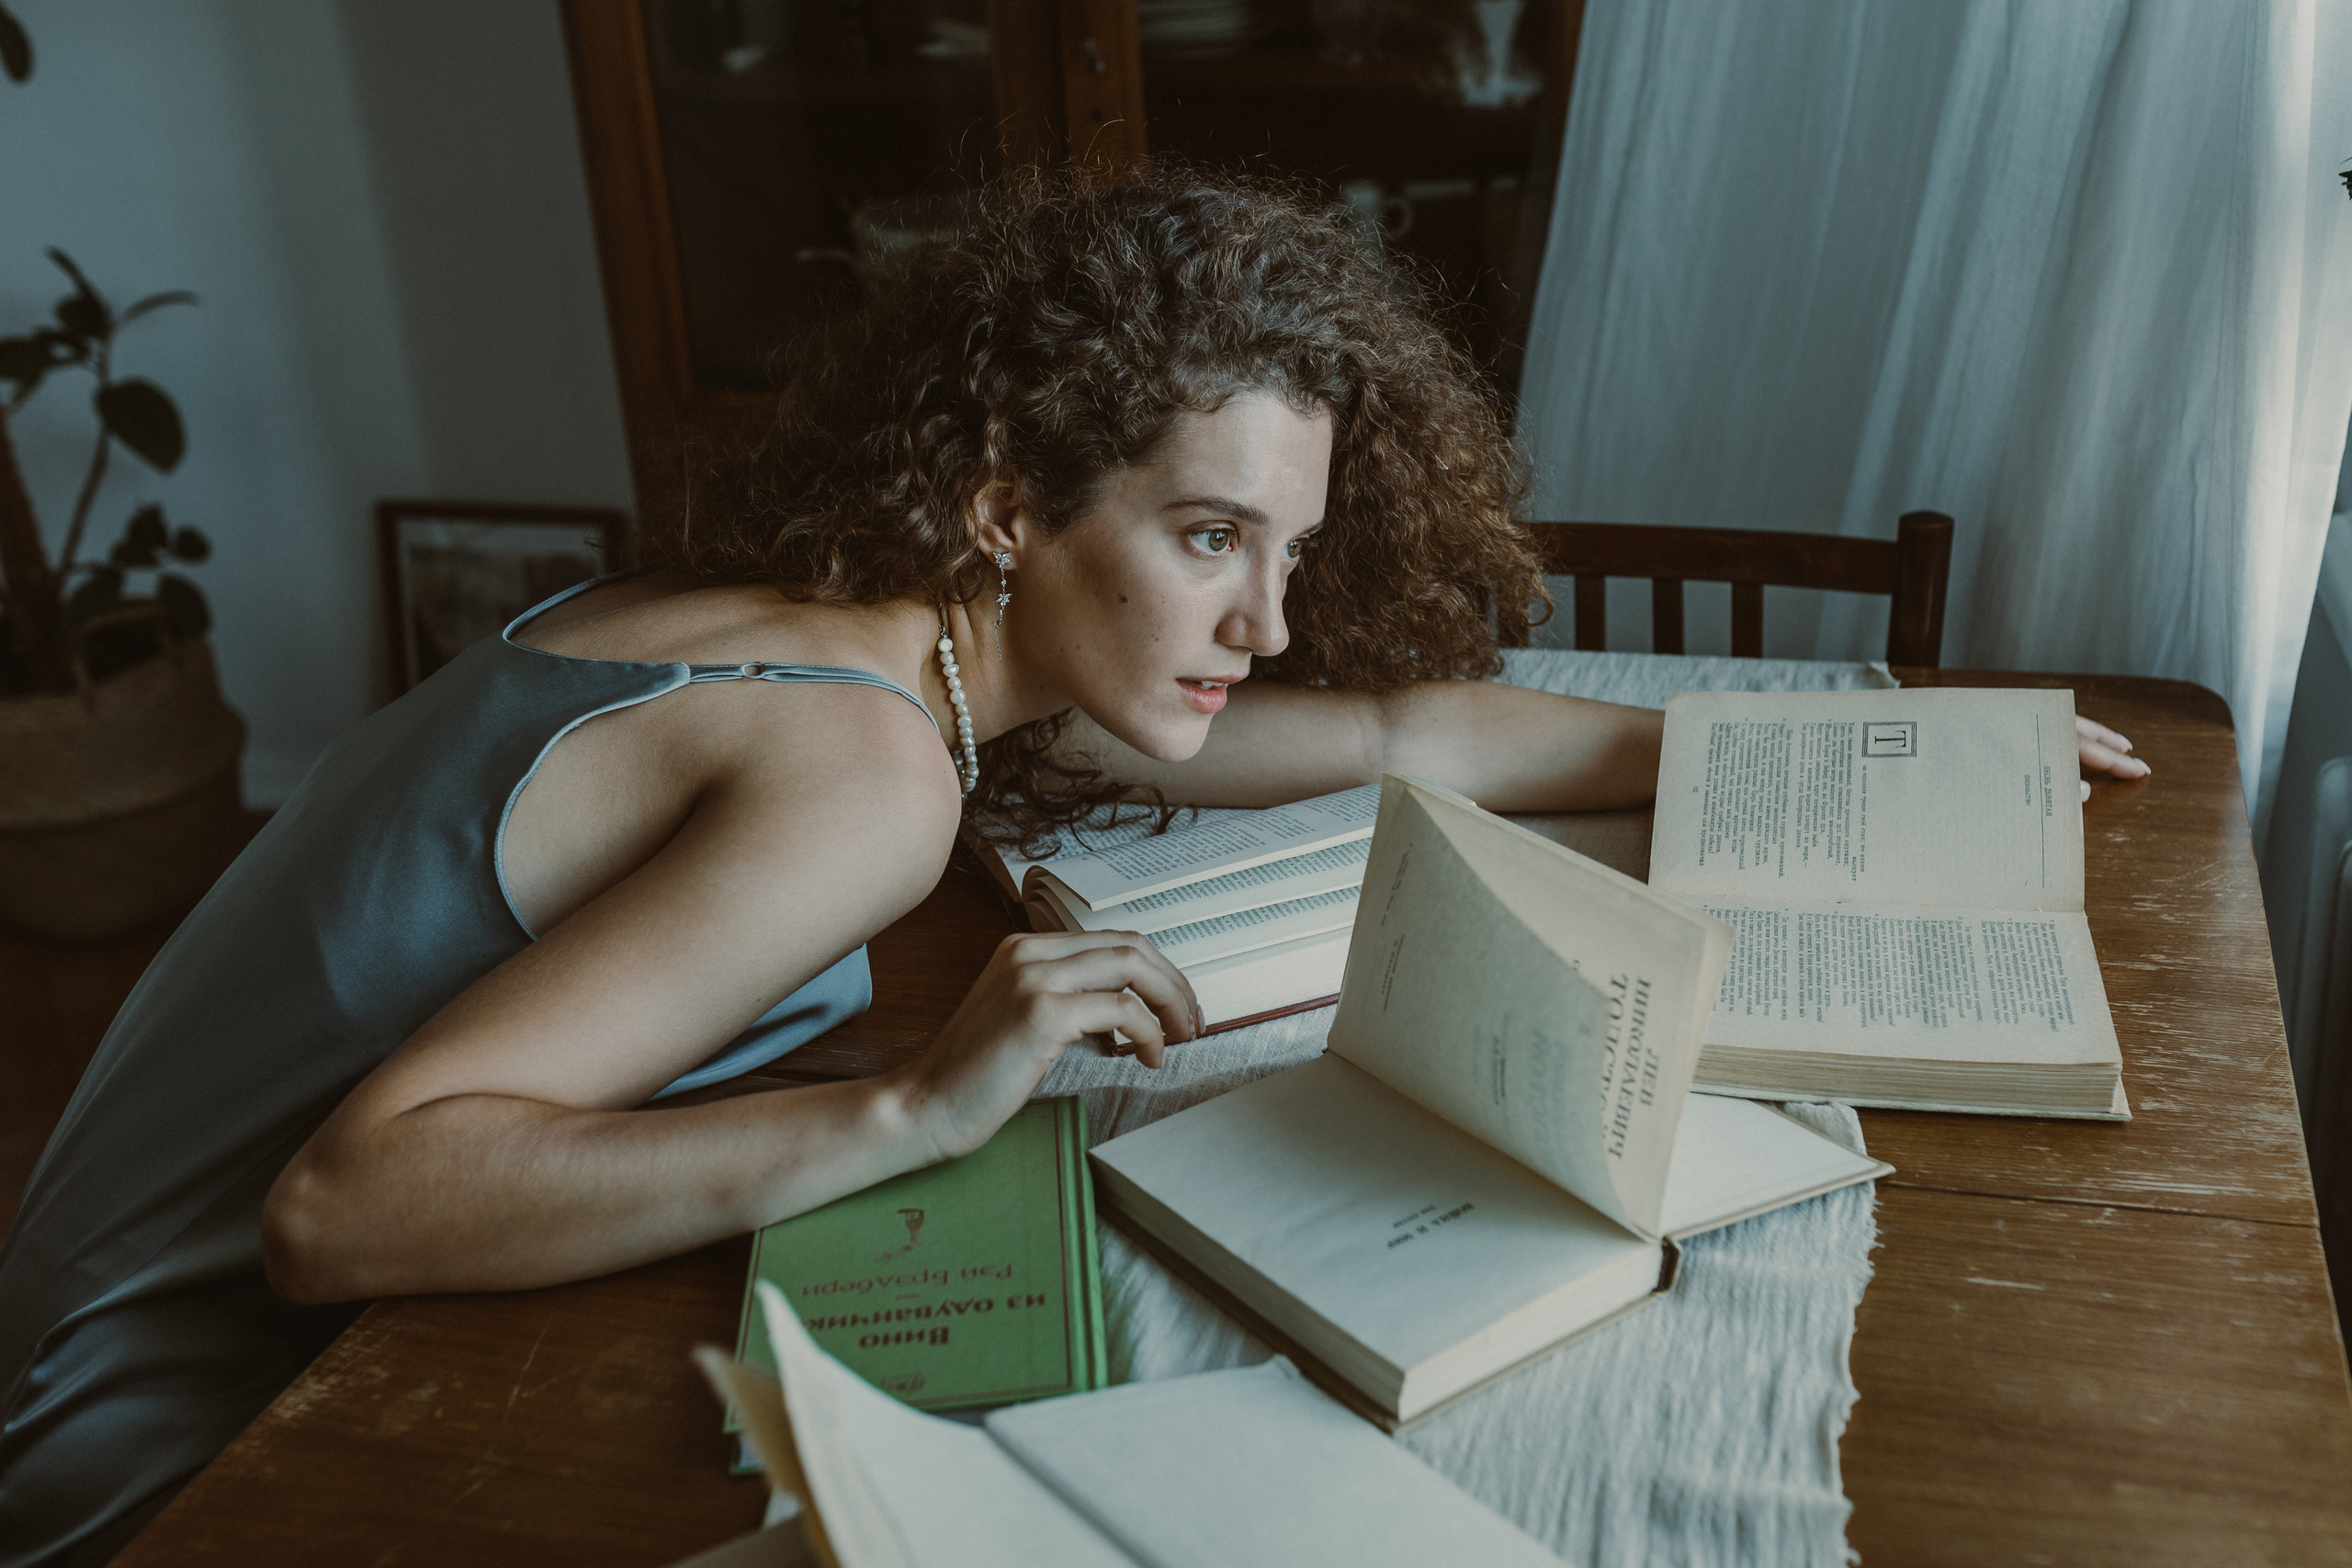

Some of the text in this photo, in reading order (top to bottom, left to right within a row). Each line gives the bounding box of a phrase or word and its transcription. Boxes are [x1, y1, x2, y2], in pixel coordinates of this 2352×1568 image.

[2043, 765, 2053, 817] ПЕСНЬ ДЕВЯТАЯ
[1601, 973, 1629, 1140] ТОЛСТ
[1609, 976, 1652, 1159] НИКОЛАЕВИЧ
[1638, 1046, 1659, 1107] ЛЕВ
[802, 1262, 1013, 1298] Рэй Брэдбери
[802, 1292, 1046, 1333] из одуванчик
[858, 1325, 951, 1349] Вино
